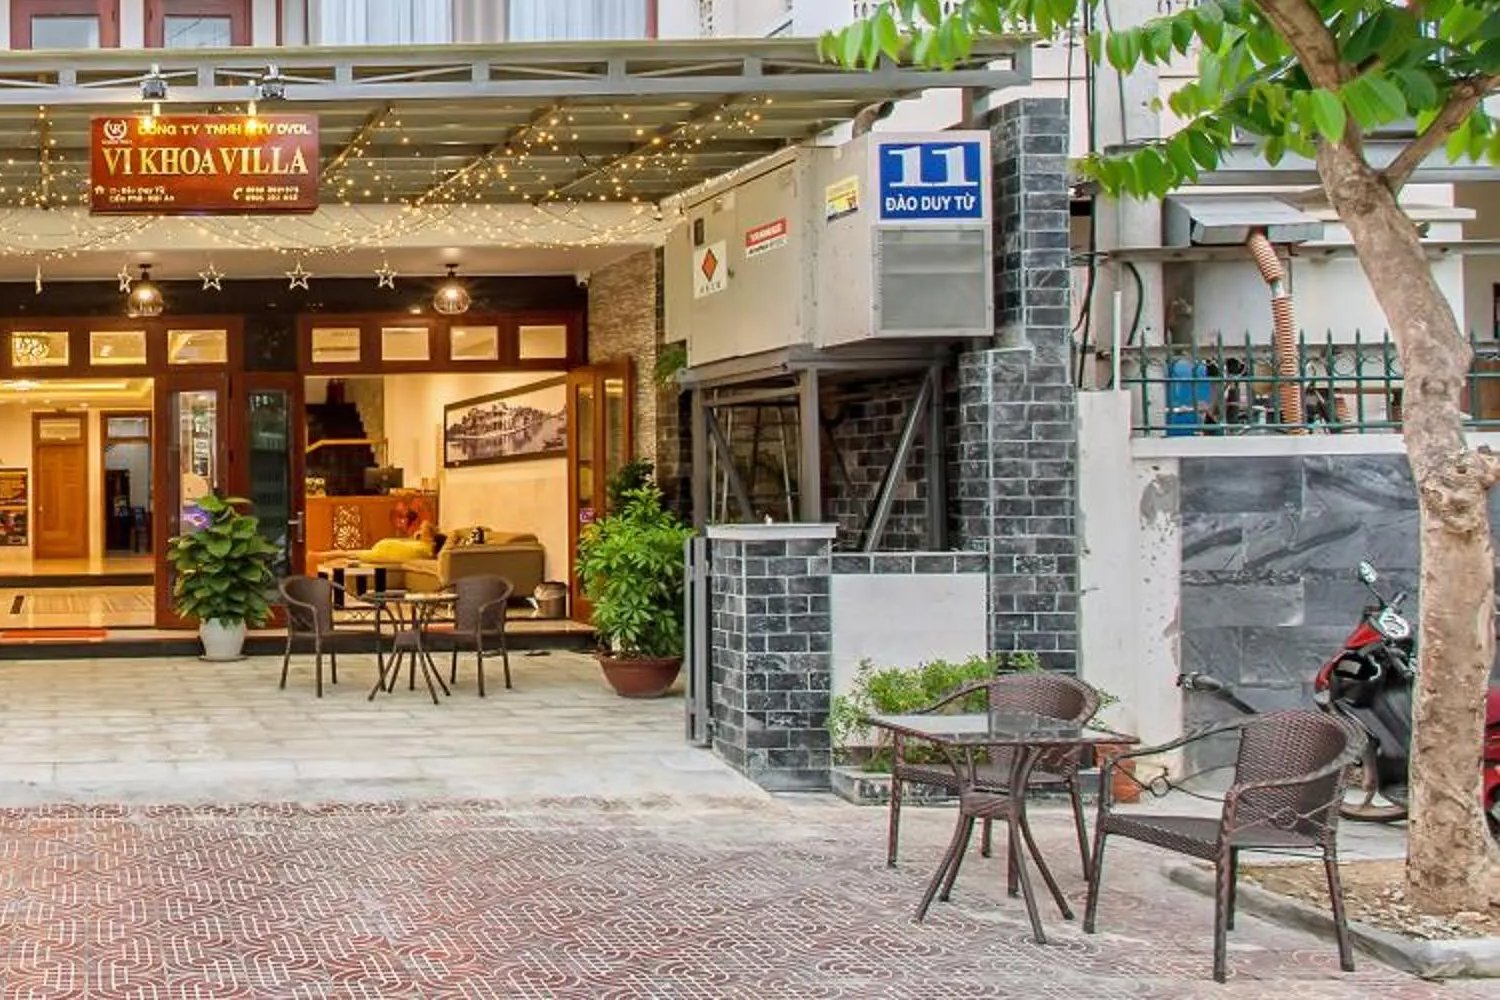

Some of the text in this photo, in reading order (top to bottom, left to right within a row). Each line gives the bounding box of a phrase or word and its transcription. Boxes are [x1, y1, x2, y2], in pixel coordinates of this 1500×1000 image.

[181, 124, 199, 135] TY
[245, 123, 274, 135] TV
[102, 145, 308, 176] VI KHOA VILLA
[888, 145, 978, 187] 11
[884, 193, 918, 211] ĐÀO
[921, 196, 951, 211] DUY
